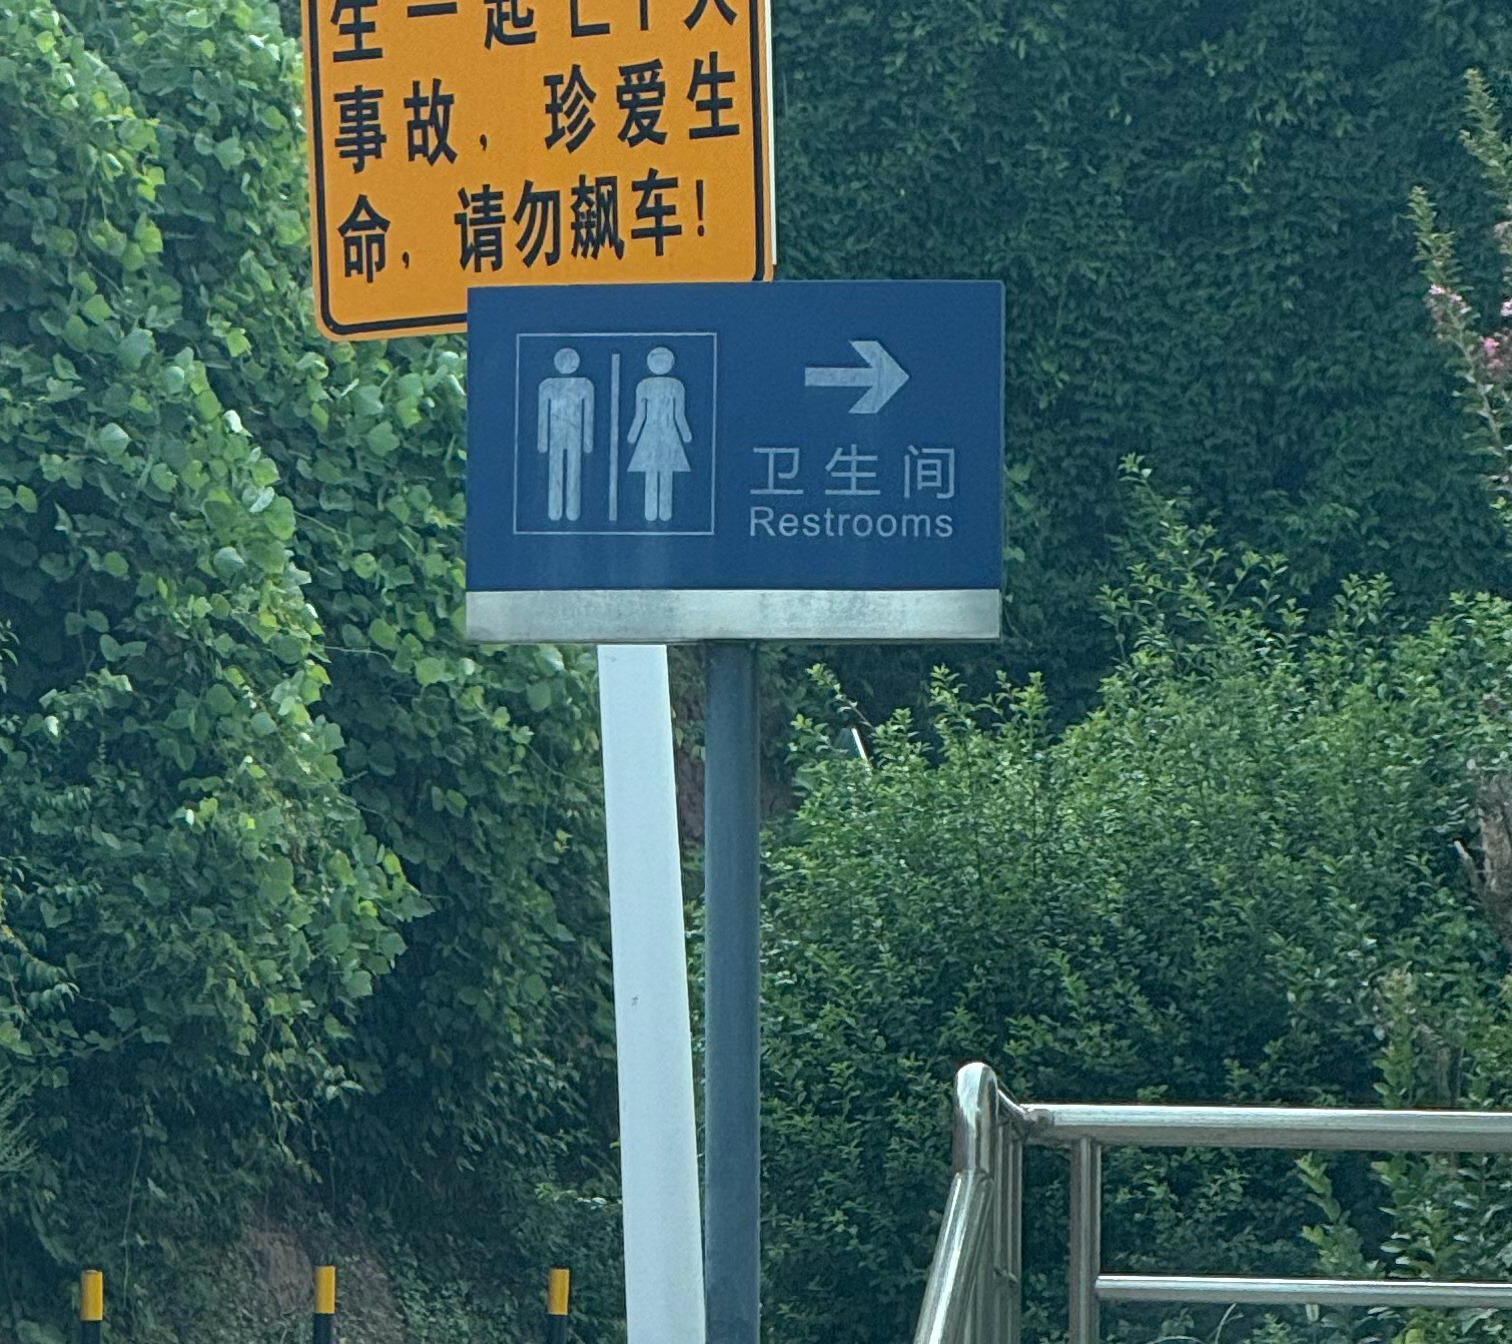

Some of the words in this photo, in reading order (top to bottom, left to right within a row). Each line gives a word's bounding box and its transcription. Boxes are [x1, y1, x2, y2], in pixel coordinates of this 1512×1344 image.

[749, 445, 955, 500] 卫生间
[750, 506, 953, 538] Restrooms
